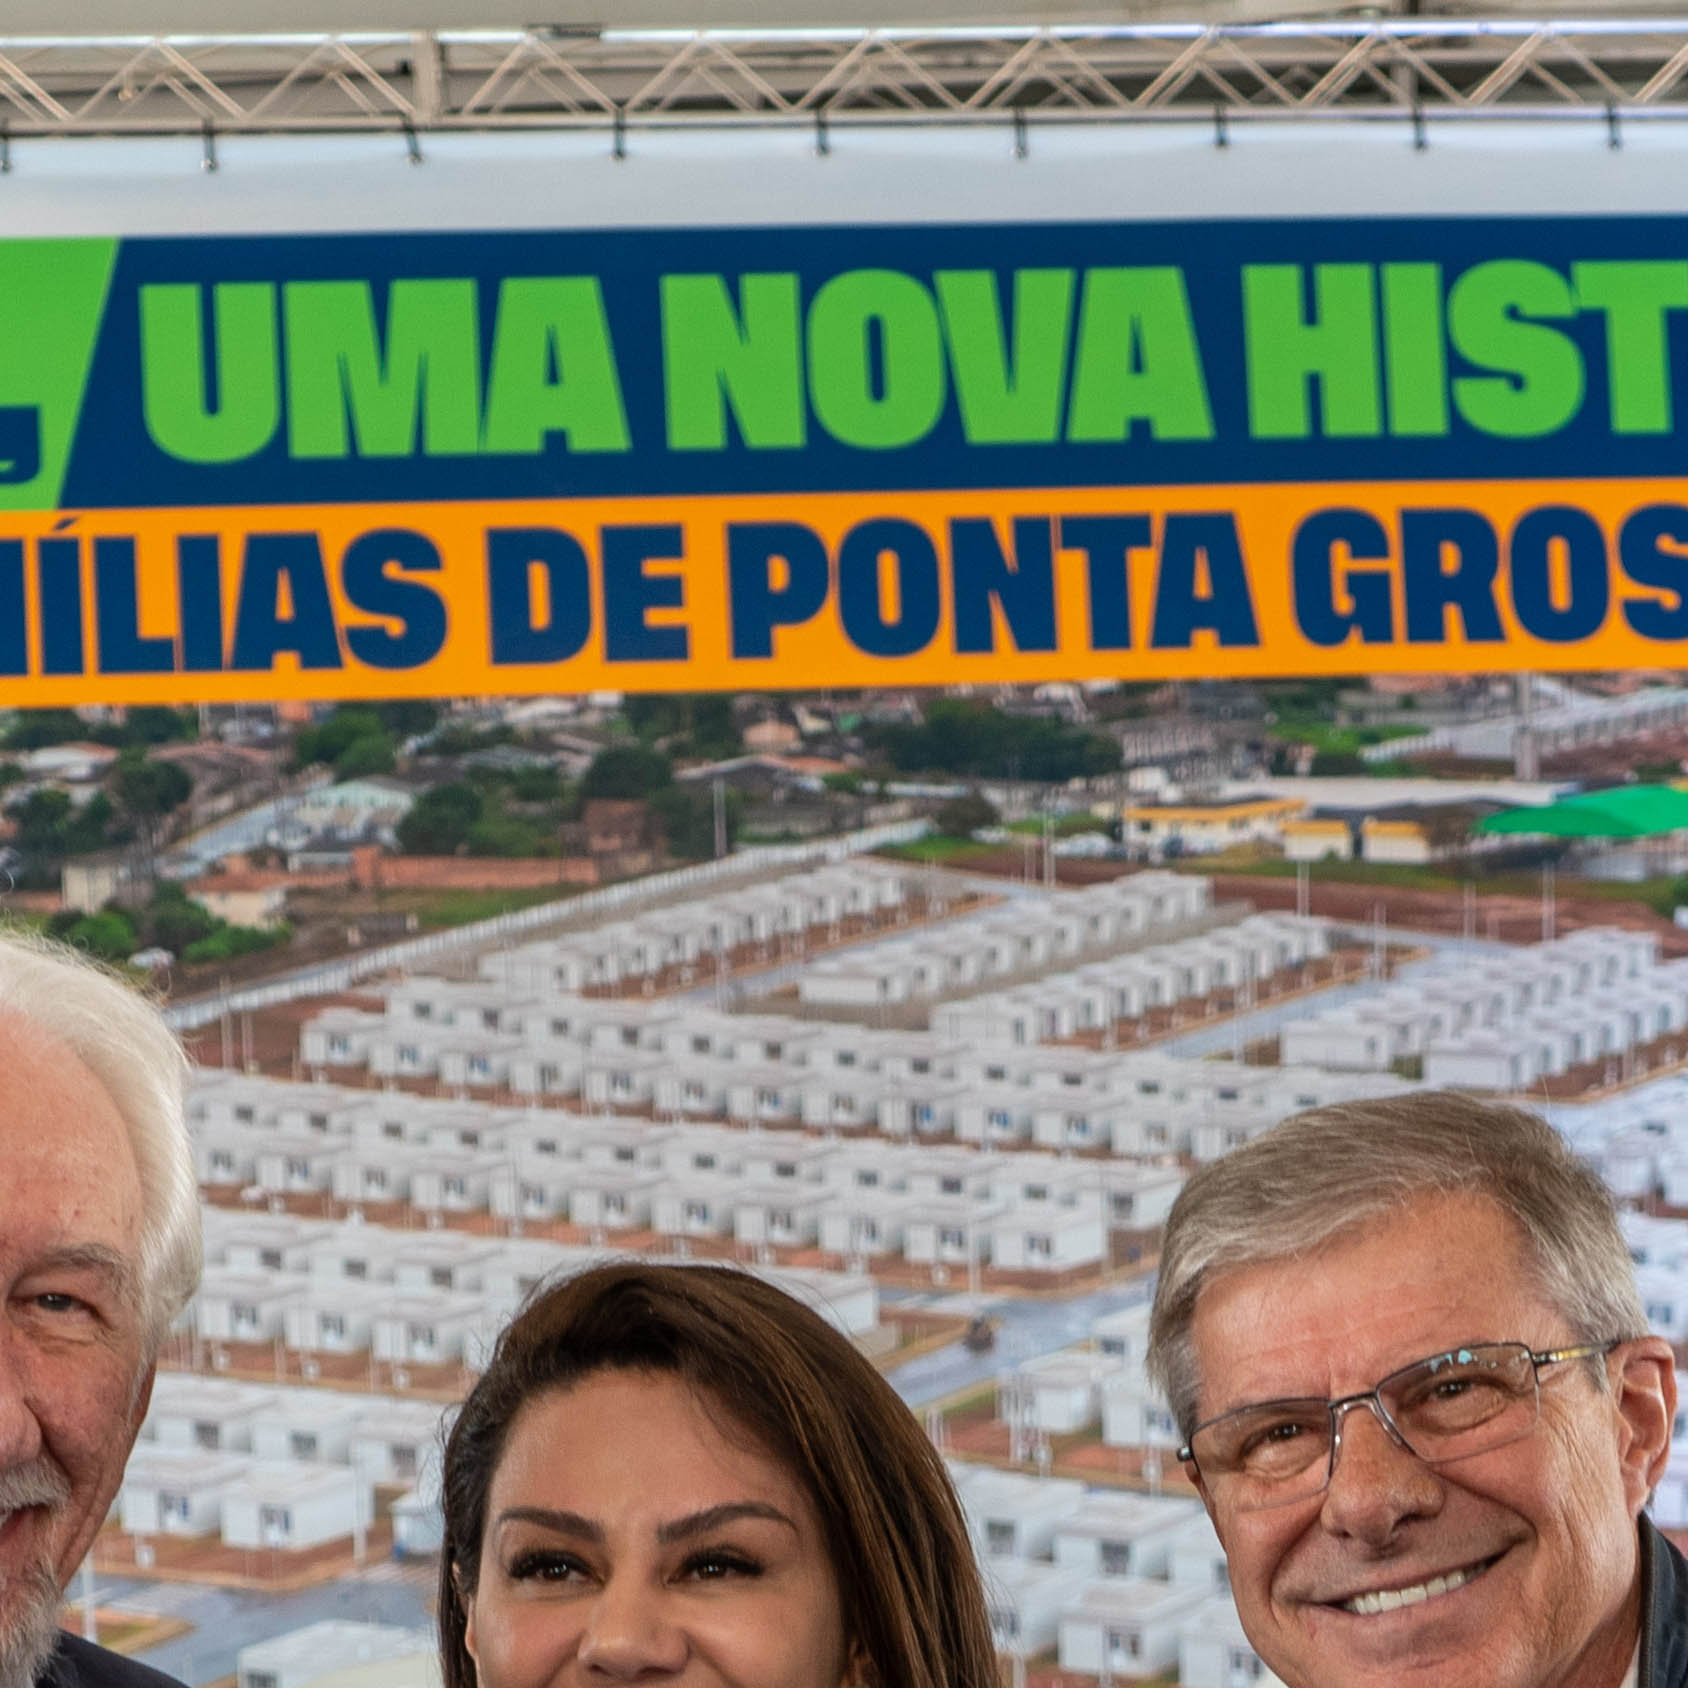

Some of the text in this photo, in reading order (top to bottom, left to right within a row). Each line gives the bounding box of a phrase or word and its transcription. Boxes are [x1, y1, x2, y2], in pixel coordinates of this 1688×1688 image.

[138, 277, 631, 466] UMA
[660, 266, 1215, 449] NOVA
[485, 523, 690, 666] DE
[725, 510, 1262, 662] PONTA
